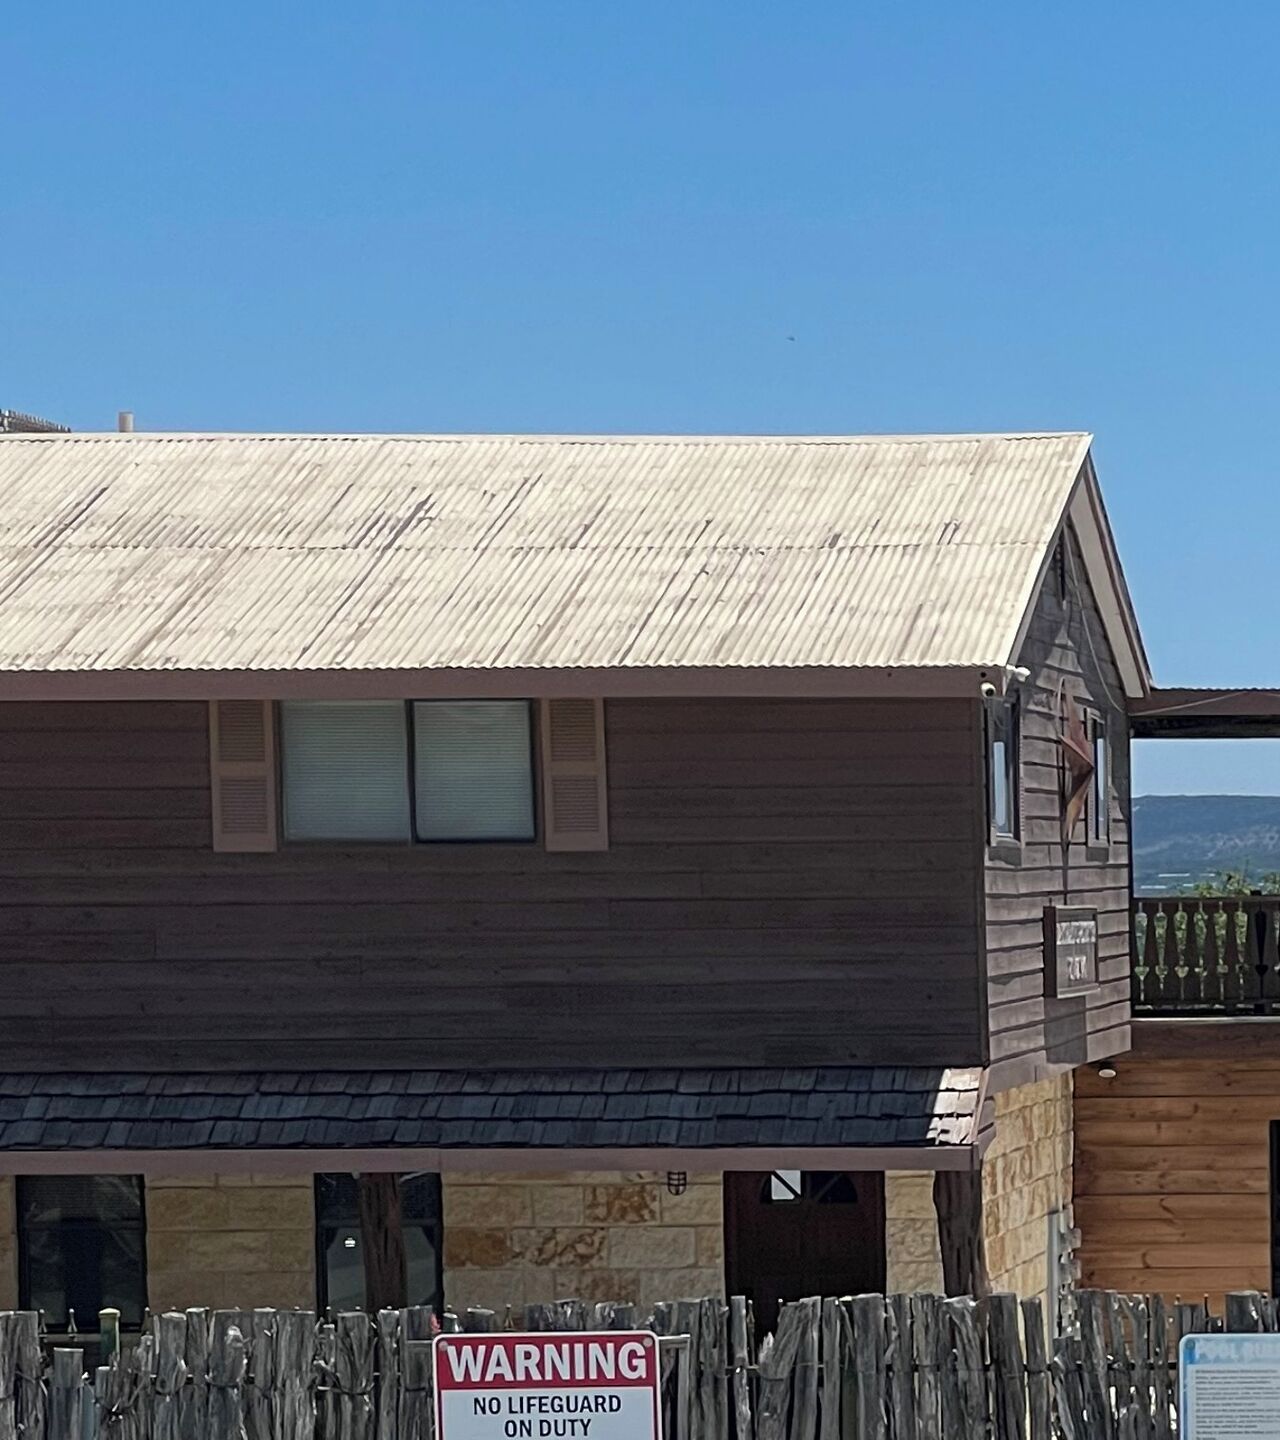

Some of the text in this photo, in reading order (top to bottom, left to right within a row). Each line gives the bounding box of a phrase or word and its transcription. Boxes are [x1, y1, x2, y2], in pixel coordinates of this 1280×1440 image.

[446, 1341, 647, 1382] WARNING
[474, 1394, 622, 1415] NO LIFEGUARD
[504, 1418, 592, 1437] ON DUTY
